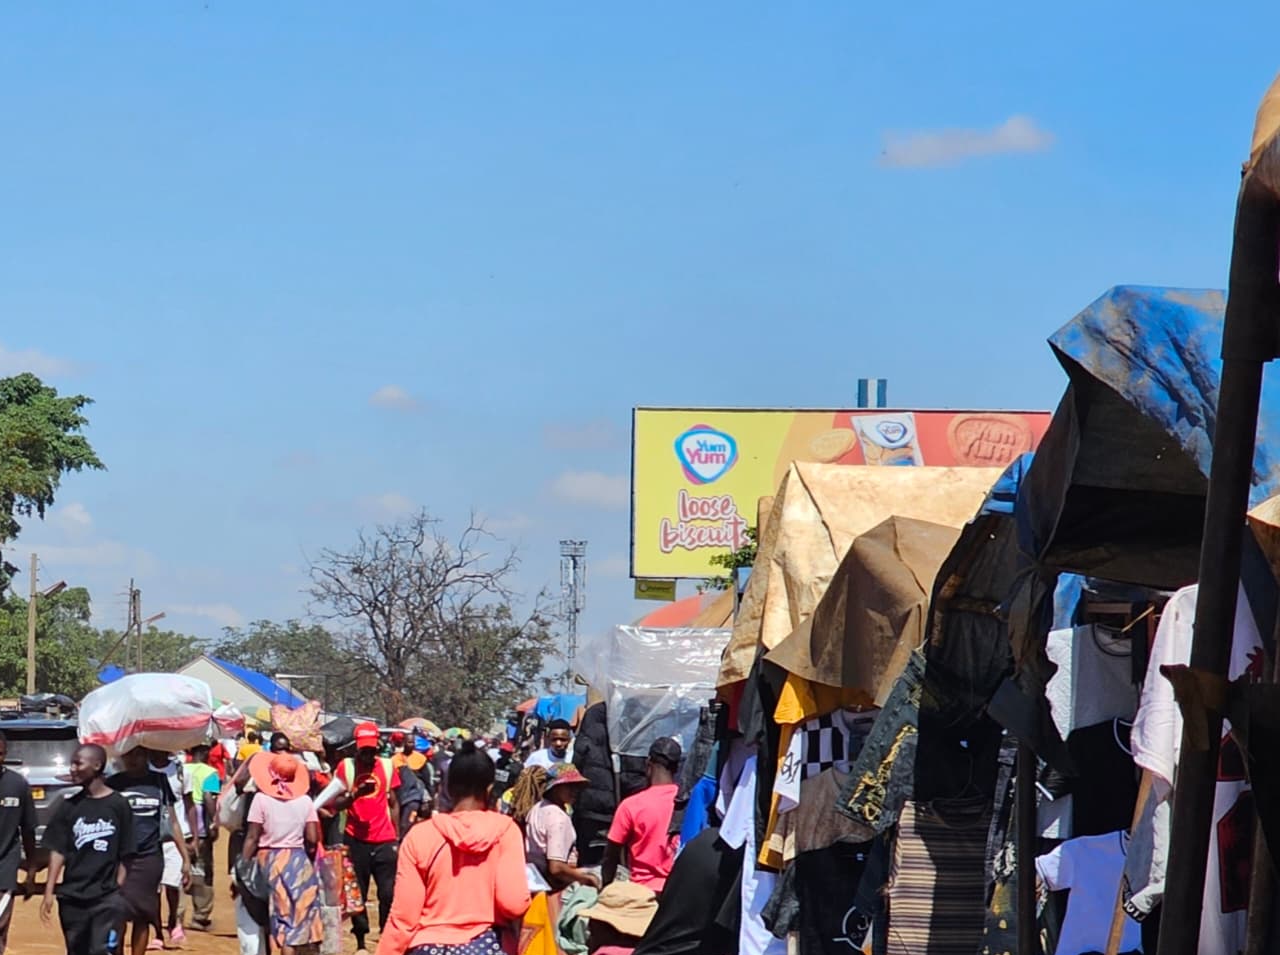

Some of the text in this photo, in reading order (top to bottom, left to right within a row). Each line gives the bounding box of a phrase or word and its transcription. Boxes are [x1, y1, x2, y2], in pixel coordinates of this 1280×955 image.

[686, 447, 726, 464] Yum
[696, 440, 726, 452] Yum
[680, 490, 734, 519] loose
[661, 516, 751, 551] biscuits
